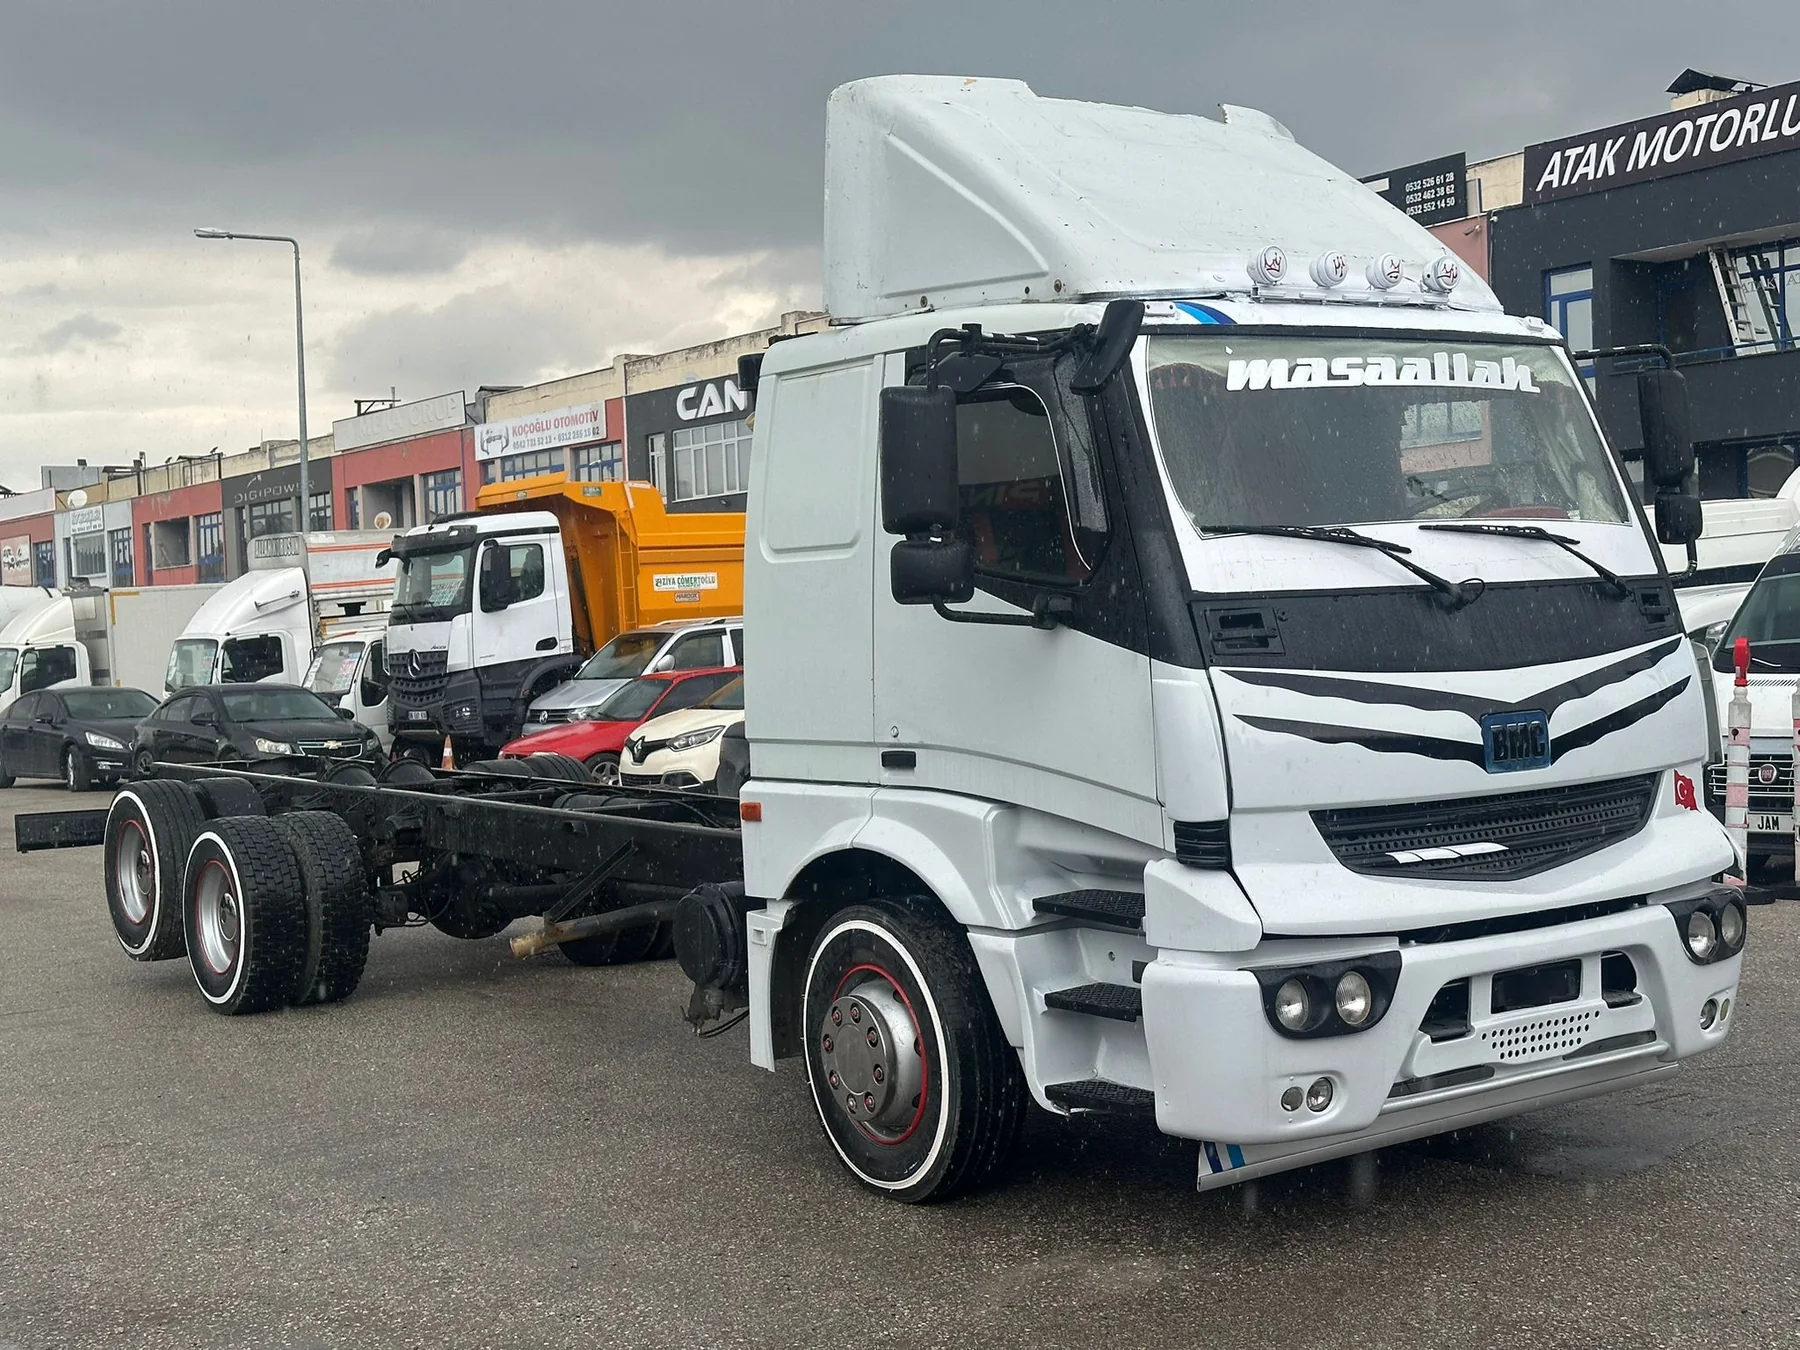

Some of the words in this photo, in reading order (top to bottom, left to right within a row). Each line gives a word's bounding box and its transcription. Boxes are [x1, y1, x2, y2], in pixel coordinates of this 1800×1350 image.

[1536, 136, 1626, 192] ATAK
[1626, 94, 1800, 173] MOTORLU
[1405, 180, 1421, 192] 0532
[1422, 177, 1435, 188] 526
[1436, 174, 1444, 185] 61
[1445, 172, 1454, 182] 28
[1405, 193, 1422, 204] 0532
[1423, 189, 1435, 200] 462
[1436, 186, 1445, 197] 38
[1445, 184, 1455, 195] 62
[1406, 204, 1422, 216] 0532
[1423, 201, 1436, 212] 552
[1437, 199, 1445, 209] 14
[1446, 196, 1455, 207] 50
[676, 379, 748, 420] CAN
[512, 417, 552, 438] KOÇOĞLU
[553, 408, 598, 430] OTOMOTİV
[557, 431, 572, 442] 0312
[592, 426, 600, 436] 02
[1490, 720, 1546, 763] BMC
[1757, 815, 1780, 831] JAM
